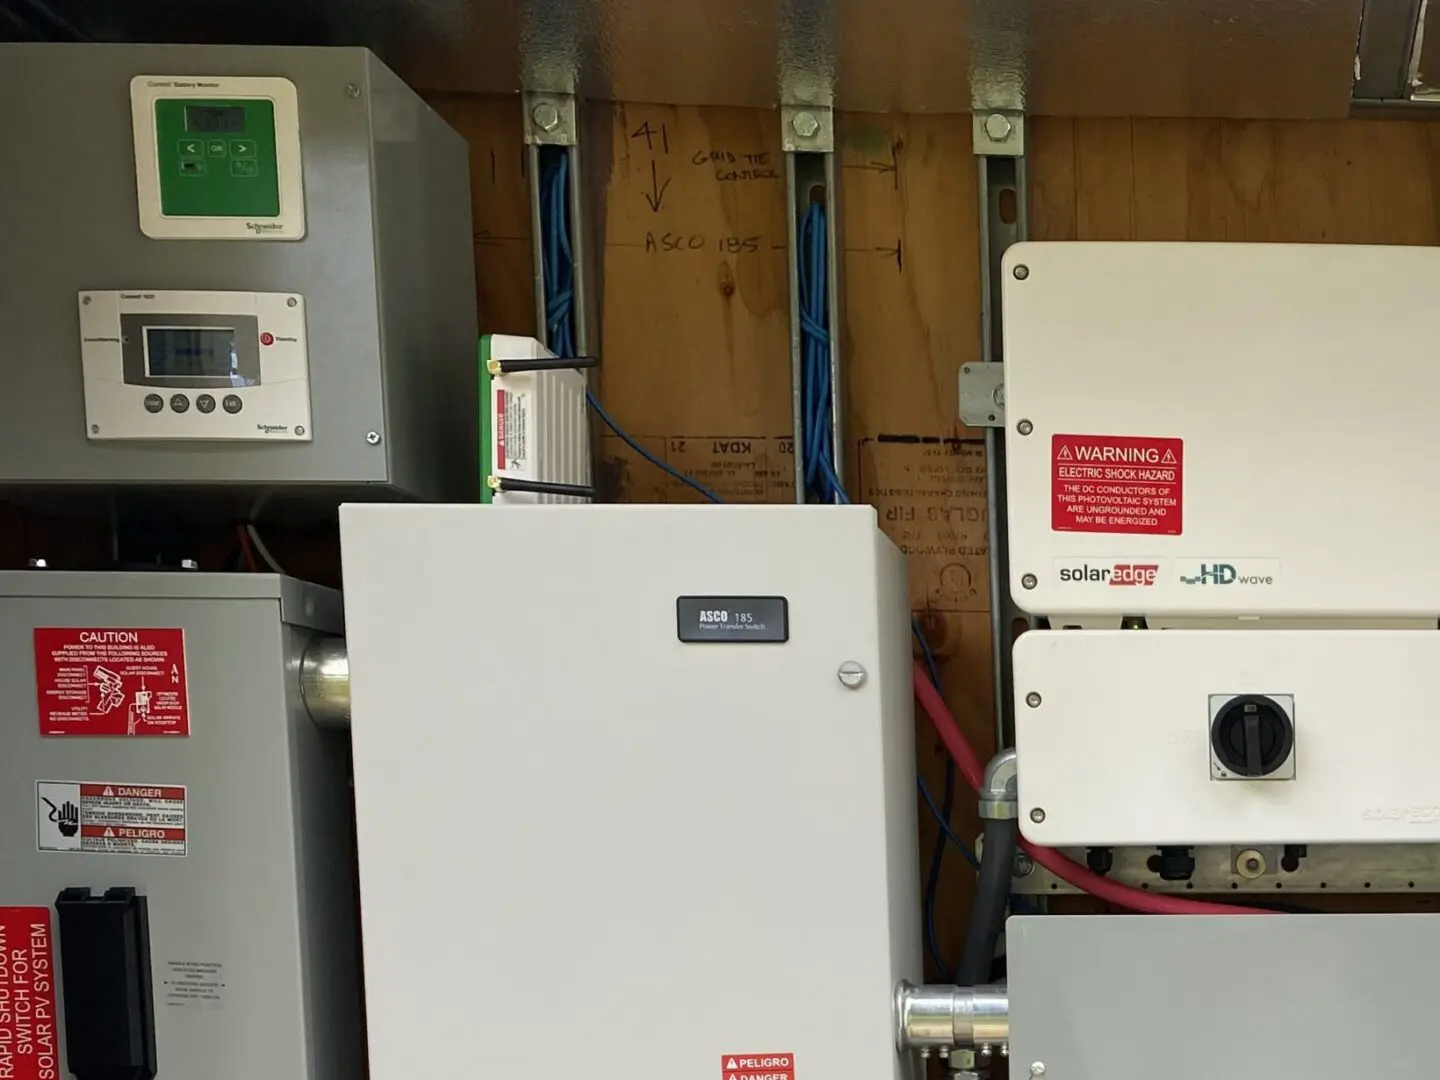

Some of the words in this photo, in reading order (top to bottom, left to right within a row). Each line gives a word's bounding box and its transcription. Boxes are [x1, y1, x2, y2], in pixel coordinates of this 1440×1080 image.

[632, 121, 668, 154] 41
[719, 236, 761, 253] 185
[1075, 446, 1158, 463] WARNING
[1059, 467, 1102, 478] ELECTRIC
[1105, 469, 1136, 480] SHOCK
[1138, 470, 1174, 481] HAZARD
[1064, 484, 1080, 492] THE
[1082, 485, 1094, 494] DC
[1097, 486, 1156, 496] CONDUCTORS
[1078, 496, 1140, 504] PHOTOVOLTAIC
[1143, 498, 1176, 506] SYSTEM
[1087, 506, 1147, 515] UNGROUNDED
[1148, 508, 1166, 516] AND
[1109, 517, 1158, 526] ENERGIZED
[1060, 564, 1158, 585] solaredge
[1201, 564, 1236, 584] HD
[1239, 575, 1273, 584] wave
[700, 610, 728, 622] ASCO
[735, 613, 752, 623] 185
[80, 632, 138, 642] CAUTION
[118, 788, 161, 797] DANGER
[120, 828, 165, 838] PELIGRO
[31, 924, 50, 992] SYSTEM
[12, 949, 28, 984] FOR
[36, 997, 50, 1020] PV
[15, 986, 32, 1054] SWITCH
[37, 1024, 54, 1080] SOLAR
[740, 1058, 789, 1068] PELIGRO
